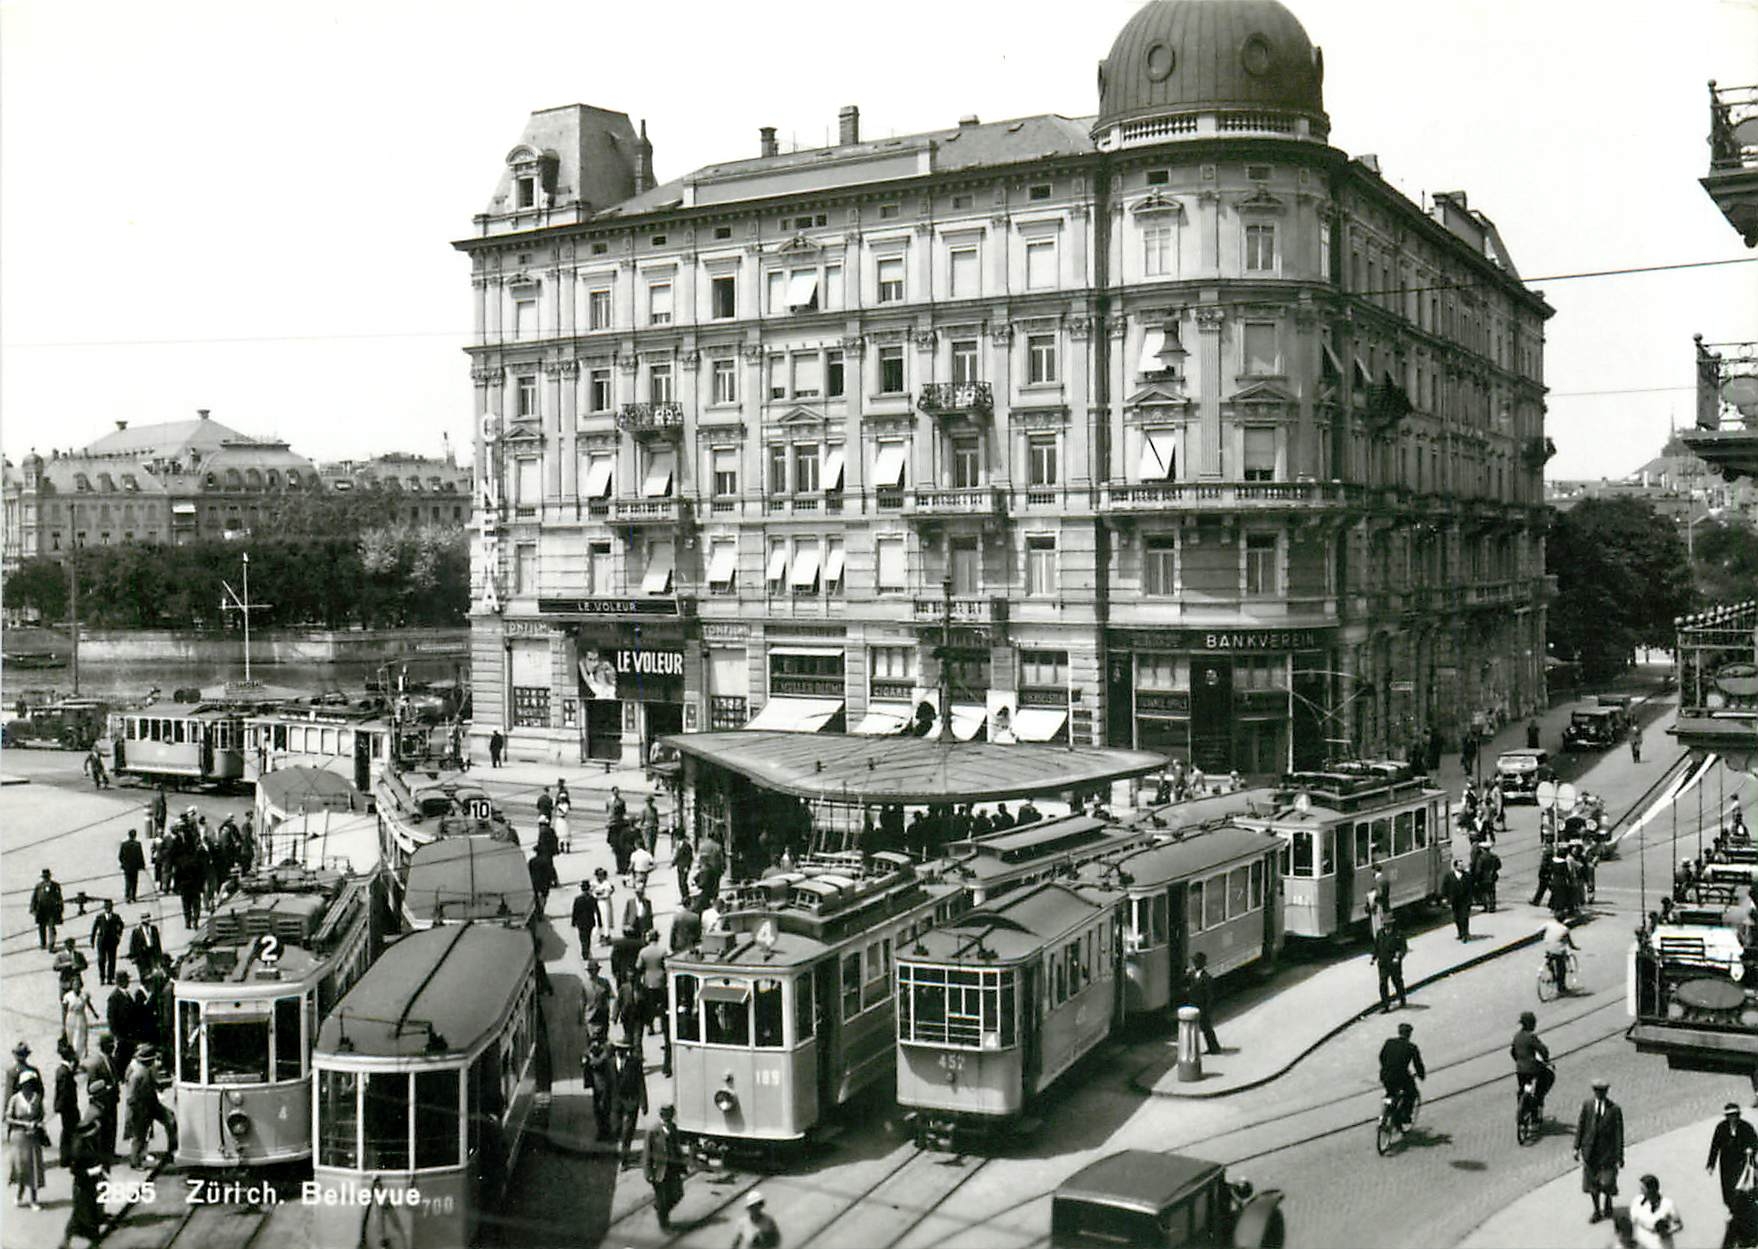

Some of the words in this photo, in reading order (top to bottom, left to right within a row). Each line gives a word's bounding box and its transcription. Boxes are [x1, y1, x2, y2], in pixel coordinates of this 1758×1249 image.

[479, 413, 500, 613] CINEMA
[577, 602, 590, 612] LE
[594, 602, 637, 612] VOLEUR
[1205, 633, 1315, 649] BANKVEREIN
[617, 651, 630, 672] LE
[632, 651, 683, 675] VOLEUR
[472, 802, 490, 819] 10
[756, 920, 774, 946] 4
[260, 935, 278, 962] 2
[985, 1033, 998, 1050] 4
